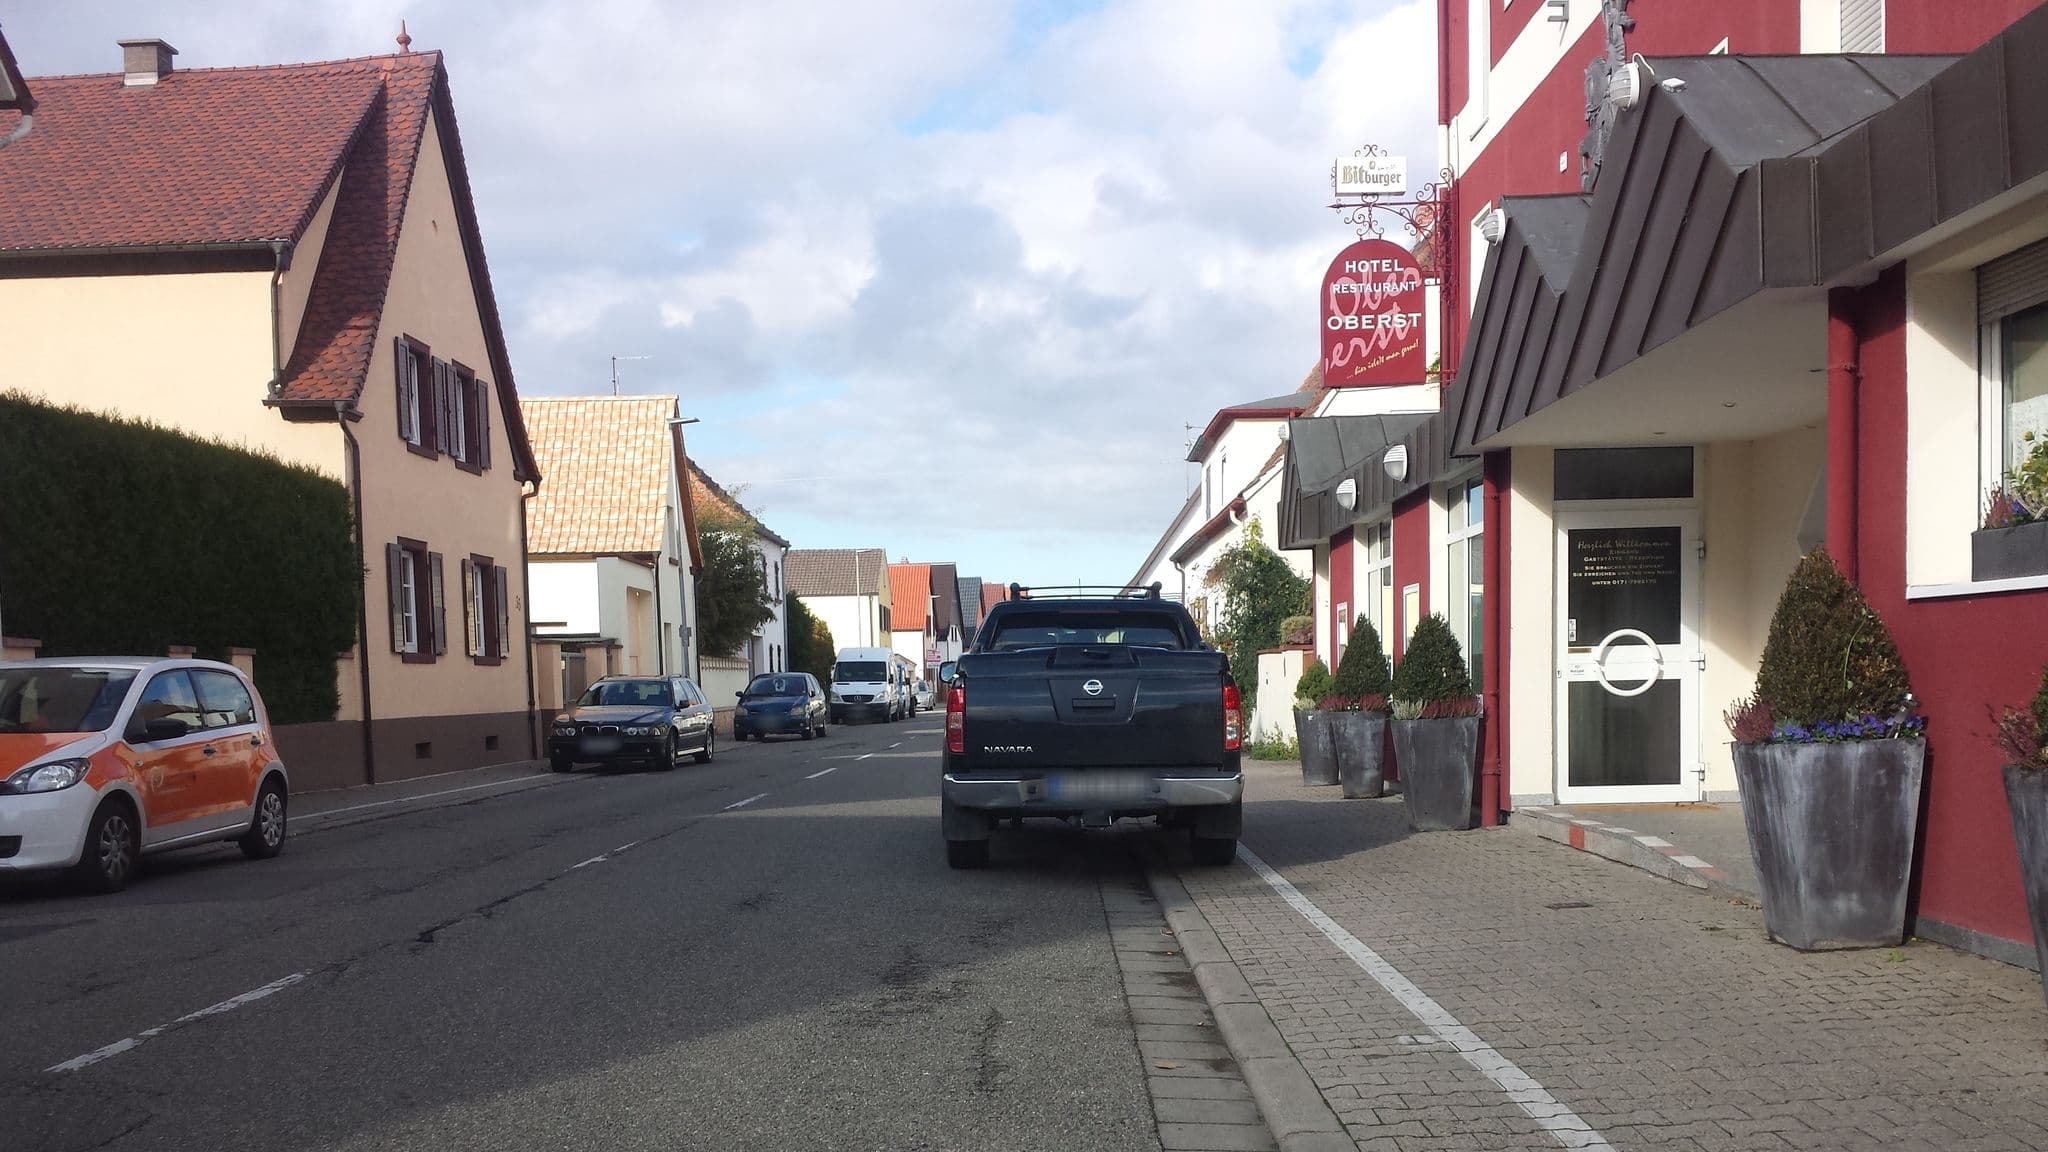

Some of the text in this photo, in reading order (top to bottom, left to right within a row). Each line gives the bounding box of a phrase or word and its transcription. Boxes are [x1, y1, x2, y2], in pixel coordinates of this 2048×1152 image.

[1341, 165, 1402, 187] Bitburger
[1345, 259, 1404, 273] HOTEL
[1333, 281, 1417, 294] RESTAURANT
[1327, 313, 1422, 330] OBERST
